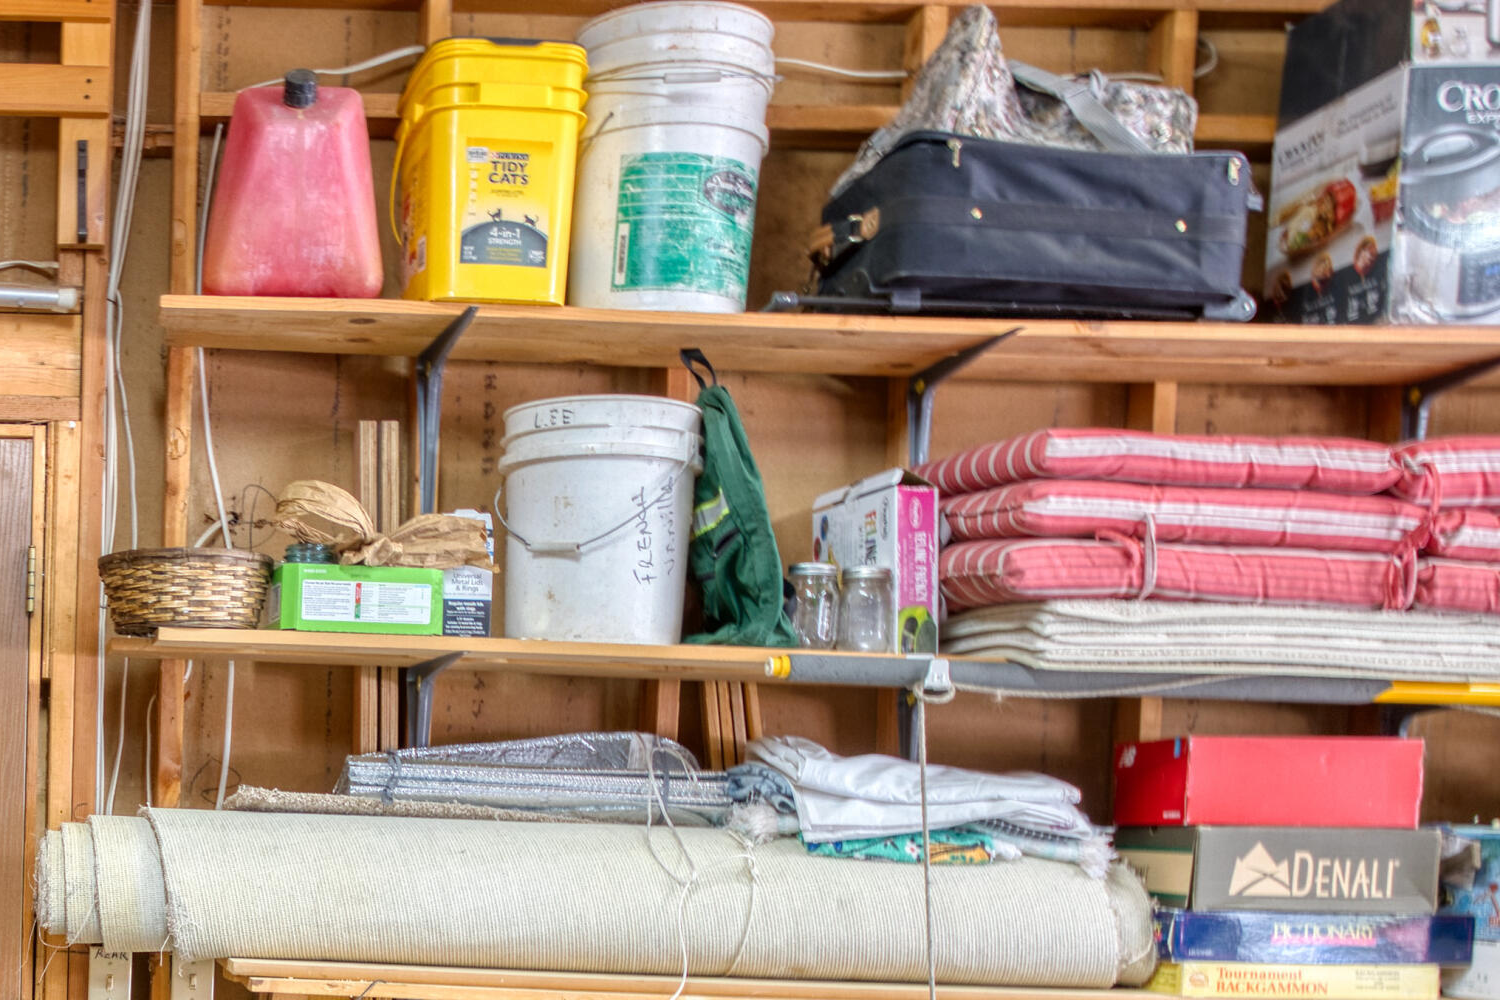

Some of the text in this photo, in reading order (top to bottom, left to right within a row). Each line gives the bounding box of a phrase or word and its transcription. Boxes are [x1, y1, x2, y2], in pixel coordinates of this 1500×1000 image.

[491, 160, 529, 173] TIDY
[488, 172, 529, 185] CATS
[489, 227, 522, 238] 4-in-1
[488, 238, 522, 246] STRENGTH
[631, 486, 657, 585] FRENCH
[864, 509, 878, 566] FELINE
[1291, 850, 1397, 899] DENALI
[1273, 921, 1374, 940] PICTIONARY
[1216, 967, 1303, 982] Tournament
[1216, 981, 1329, 996] BACKGAMMON
